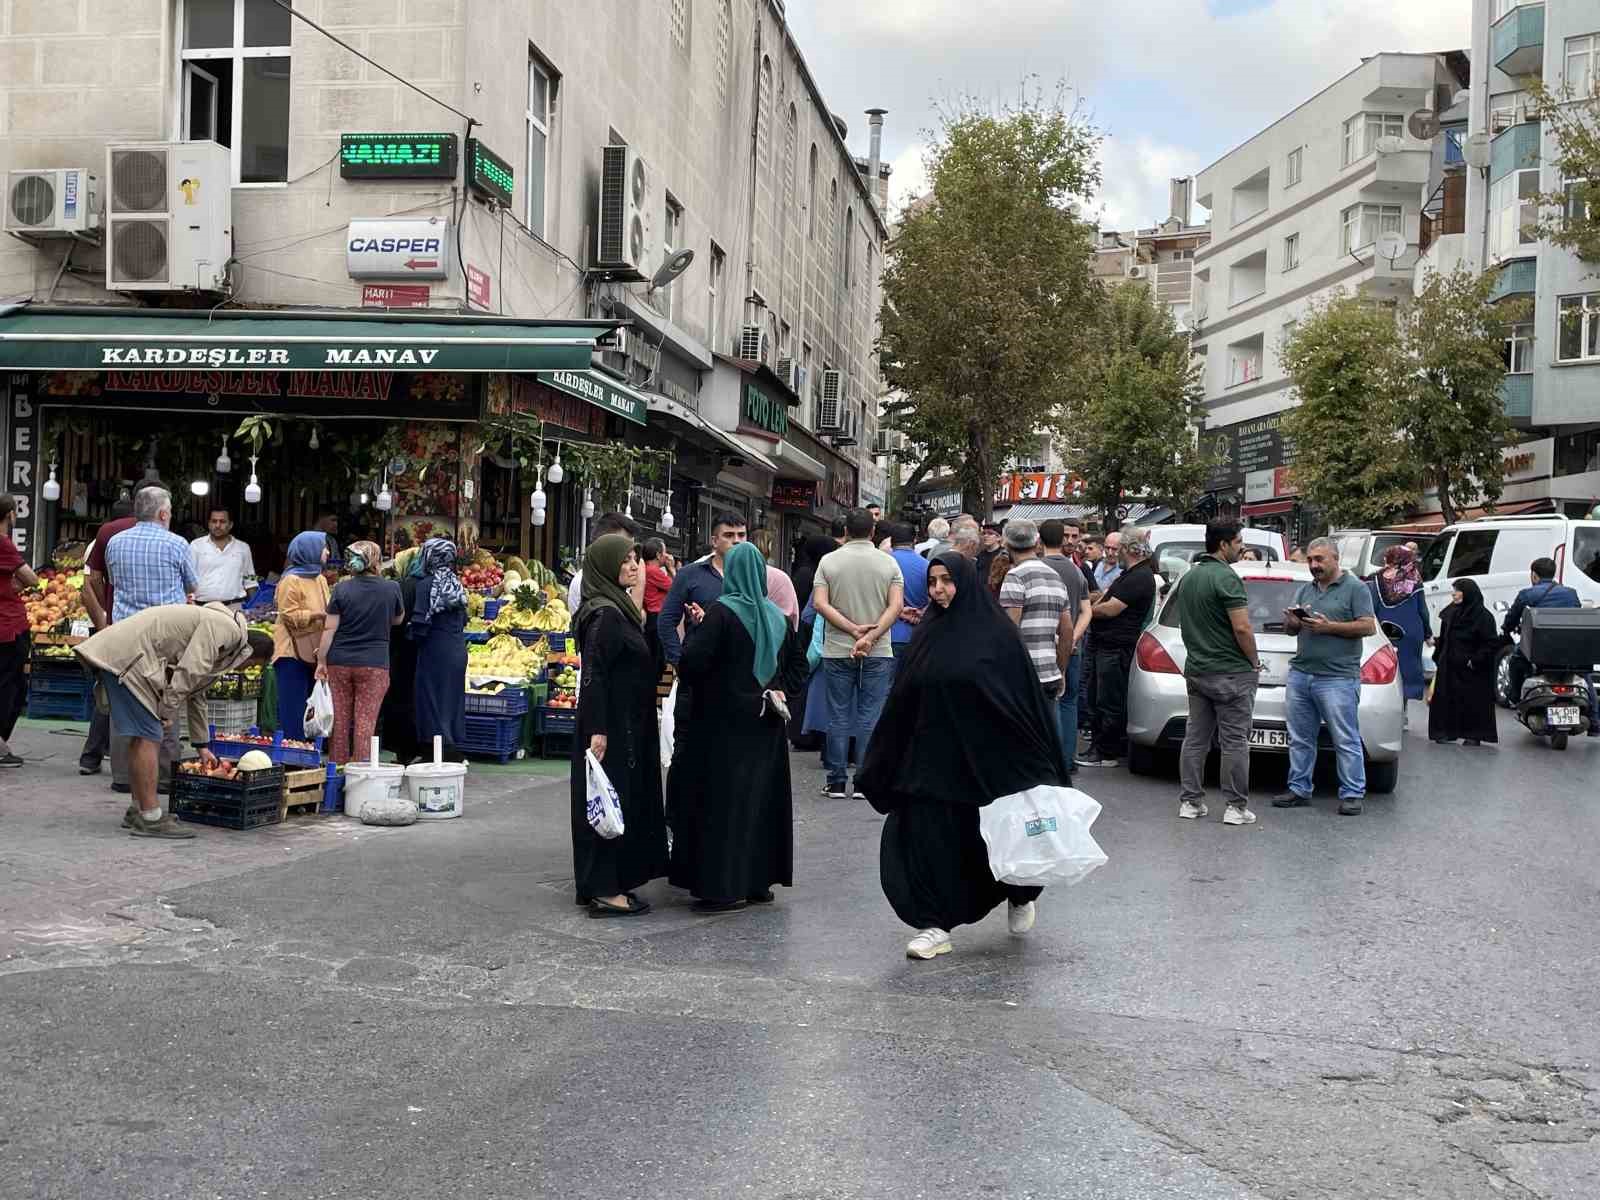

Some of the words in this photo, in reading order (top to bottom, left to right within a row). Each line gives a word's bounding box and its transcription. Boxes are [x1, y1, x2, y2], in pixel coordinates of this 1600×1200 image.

[349, 238, 440, 253] CASPER
[101, 348, 290, 367] KARDEŞLER
[324, 348, 440, 365] MANAV
